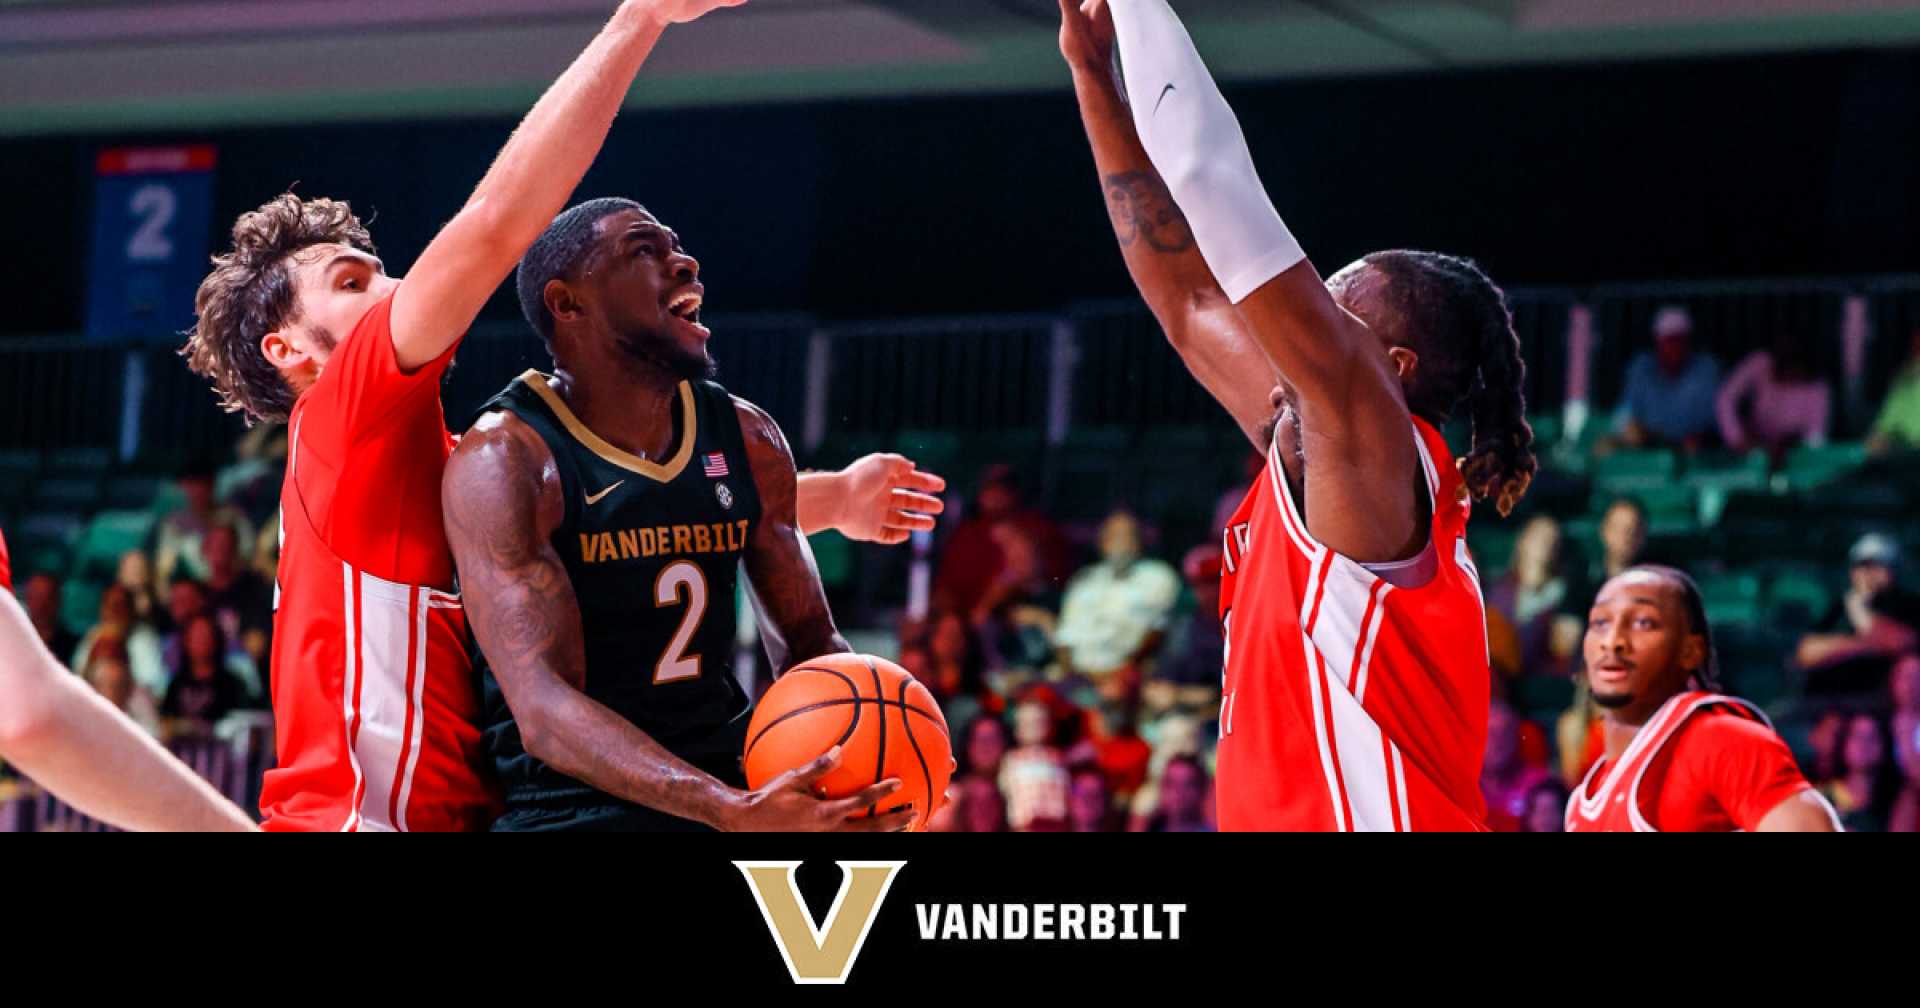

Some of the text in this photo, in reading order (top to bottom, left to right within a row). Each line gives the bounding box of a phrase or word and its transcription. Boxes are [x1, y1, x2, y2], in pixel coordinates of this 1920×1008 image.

[127, 183, 176, 259] 2
[579, 519, 749, 563] VANDERBILT
[653, 559, 709, 686] 2
